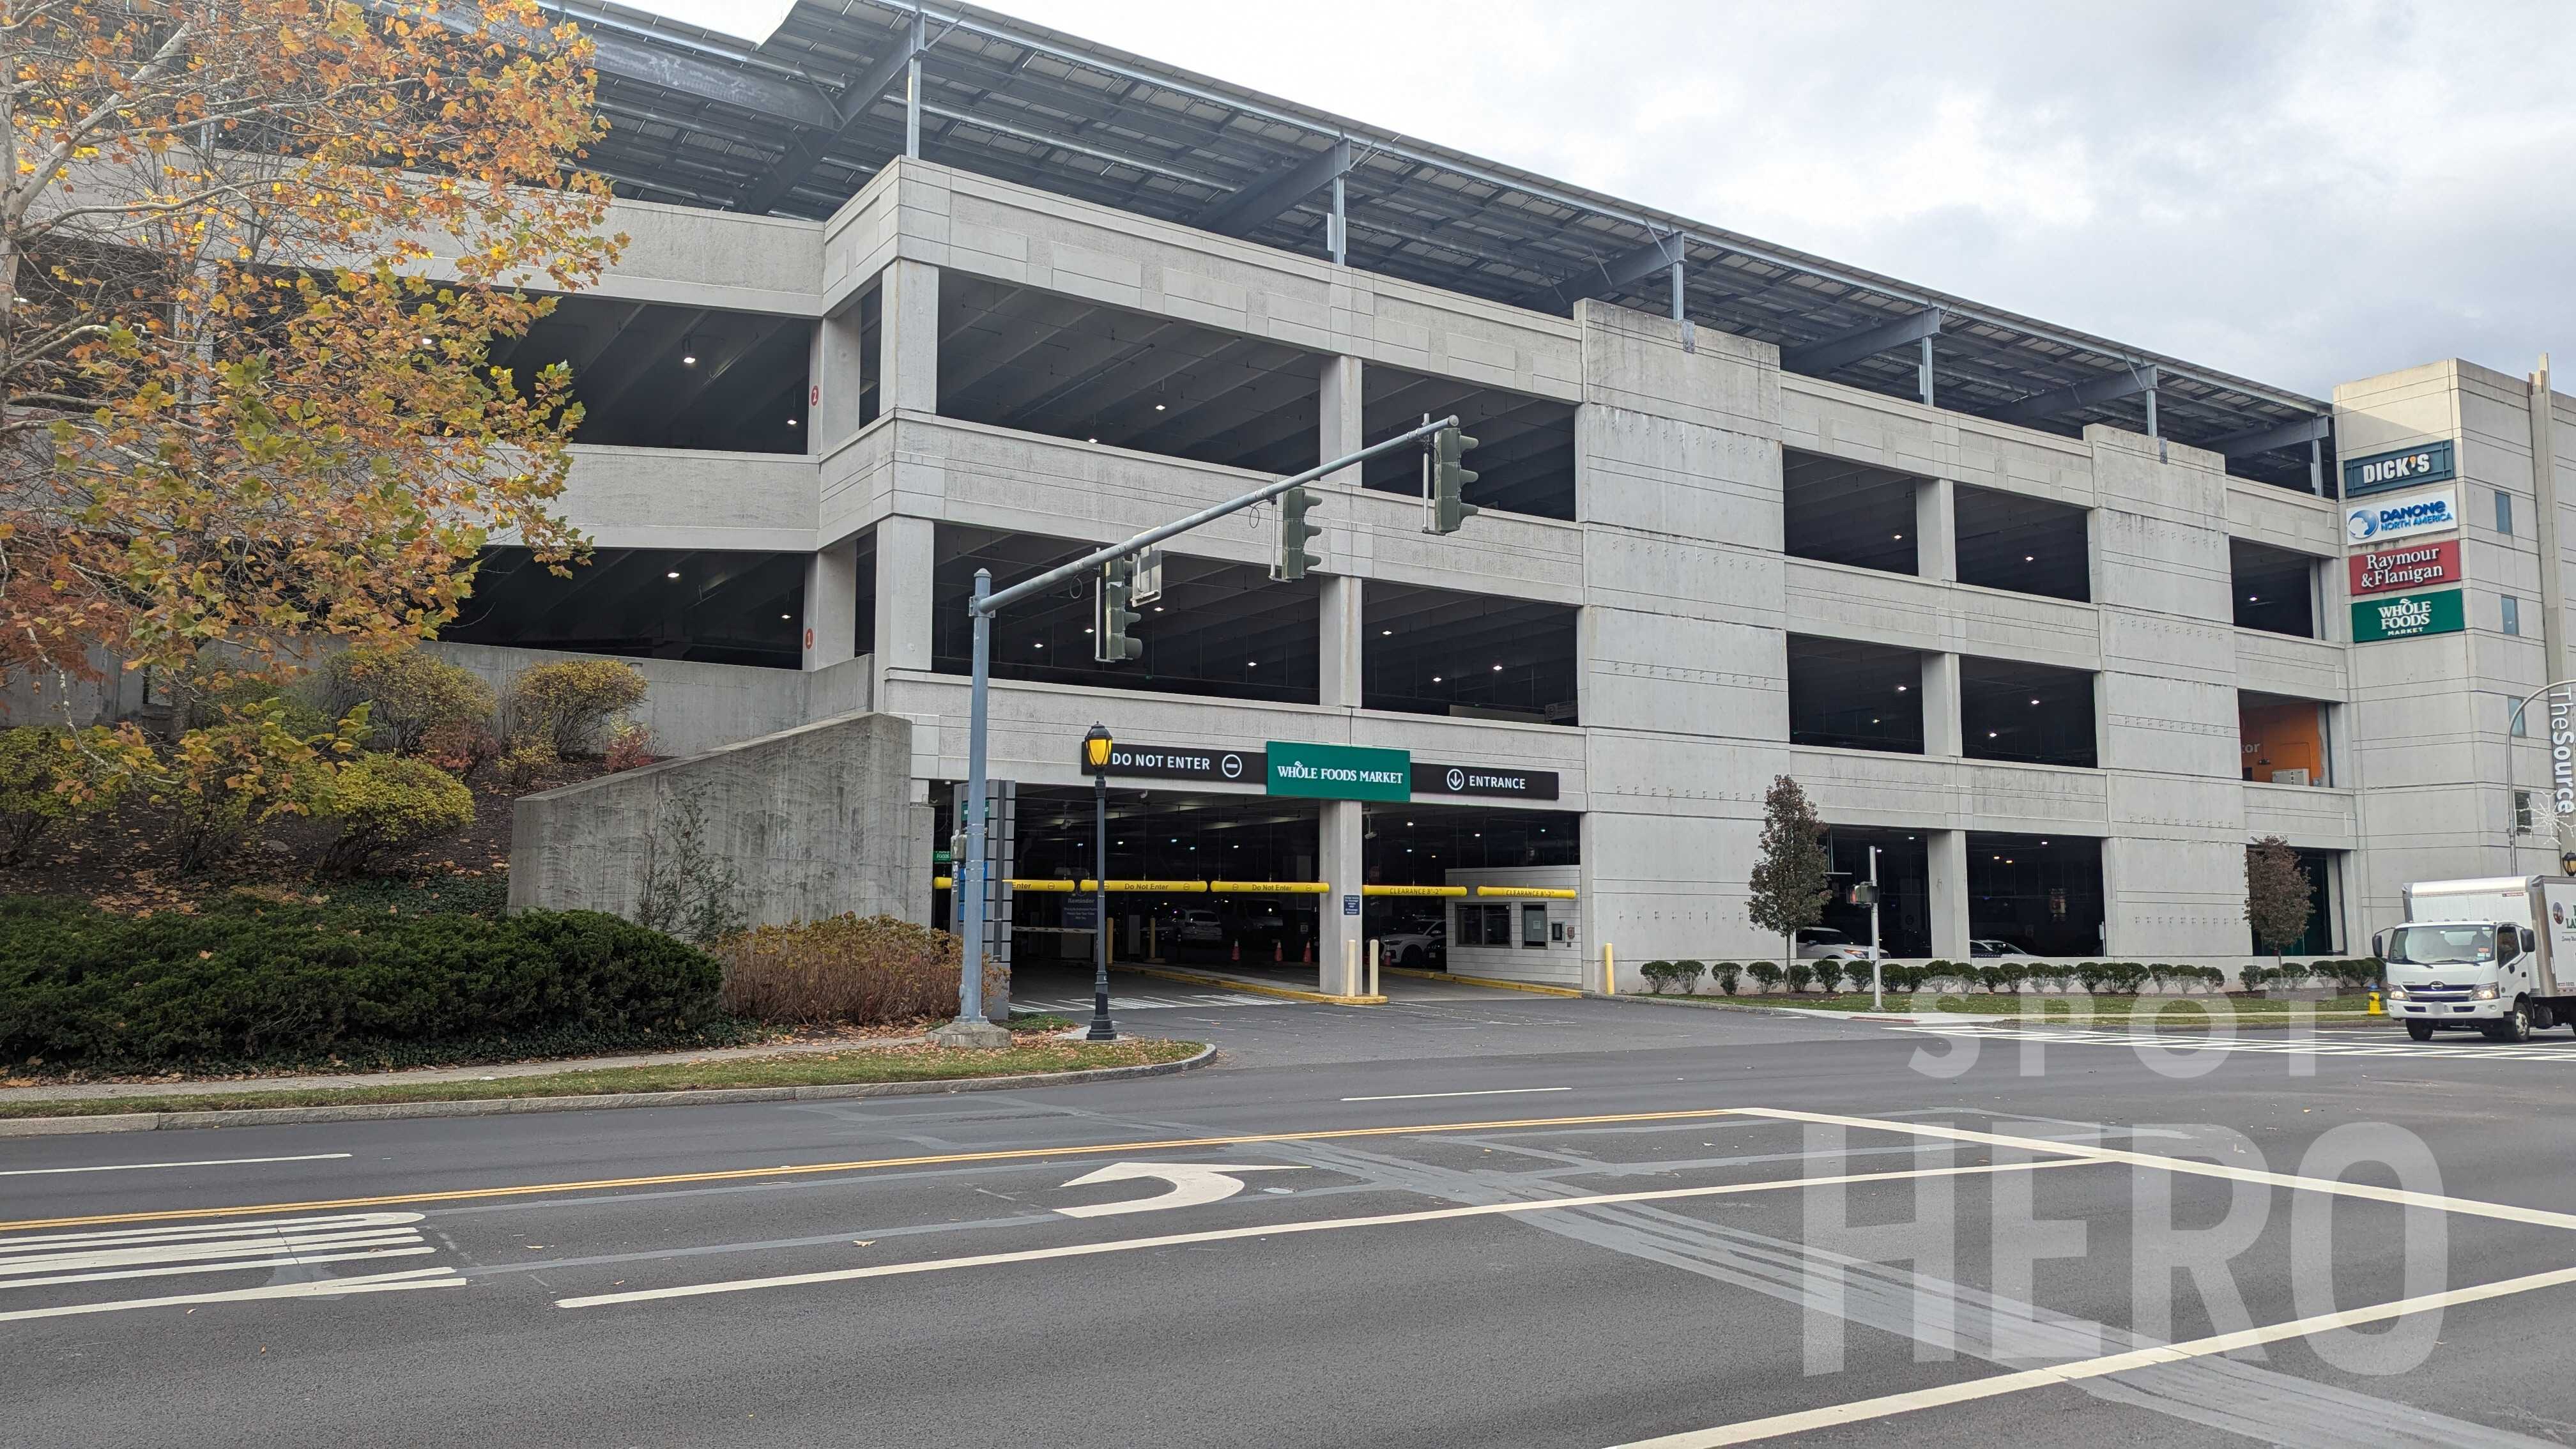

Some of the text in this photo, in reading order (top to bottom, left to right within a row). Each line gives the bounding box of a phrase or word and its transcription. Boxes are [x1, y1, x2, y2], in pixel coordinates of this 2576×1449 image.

[813, 389, 817, 402] 2
[2363, 454, 2430, 484] DICK'S
[2381, 512, 2453, 532] NORTH AMERICA
[2366, 548, 2439, 570] Raymour
[2378, 599, 2432, 618] WHOLE
[2381, 613, 2430, 630] FOODS
[807, 632, 811, 645] 1
[2387, 627, 2423, 636] MARKET
[2550, 687, 2575, 814] TheSource
[1112, 753, 1210, 770] DO NOT ENTER
[1277, 762, 1403, 784] WHOLE FOODS MARKET
[1469, 775, 1526, 790] ENTRANCE
